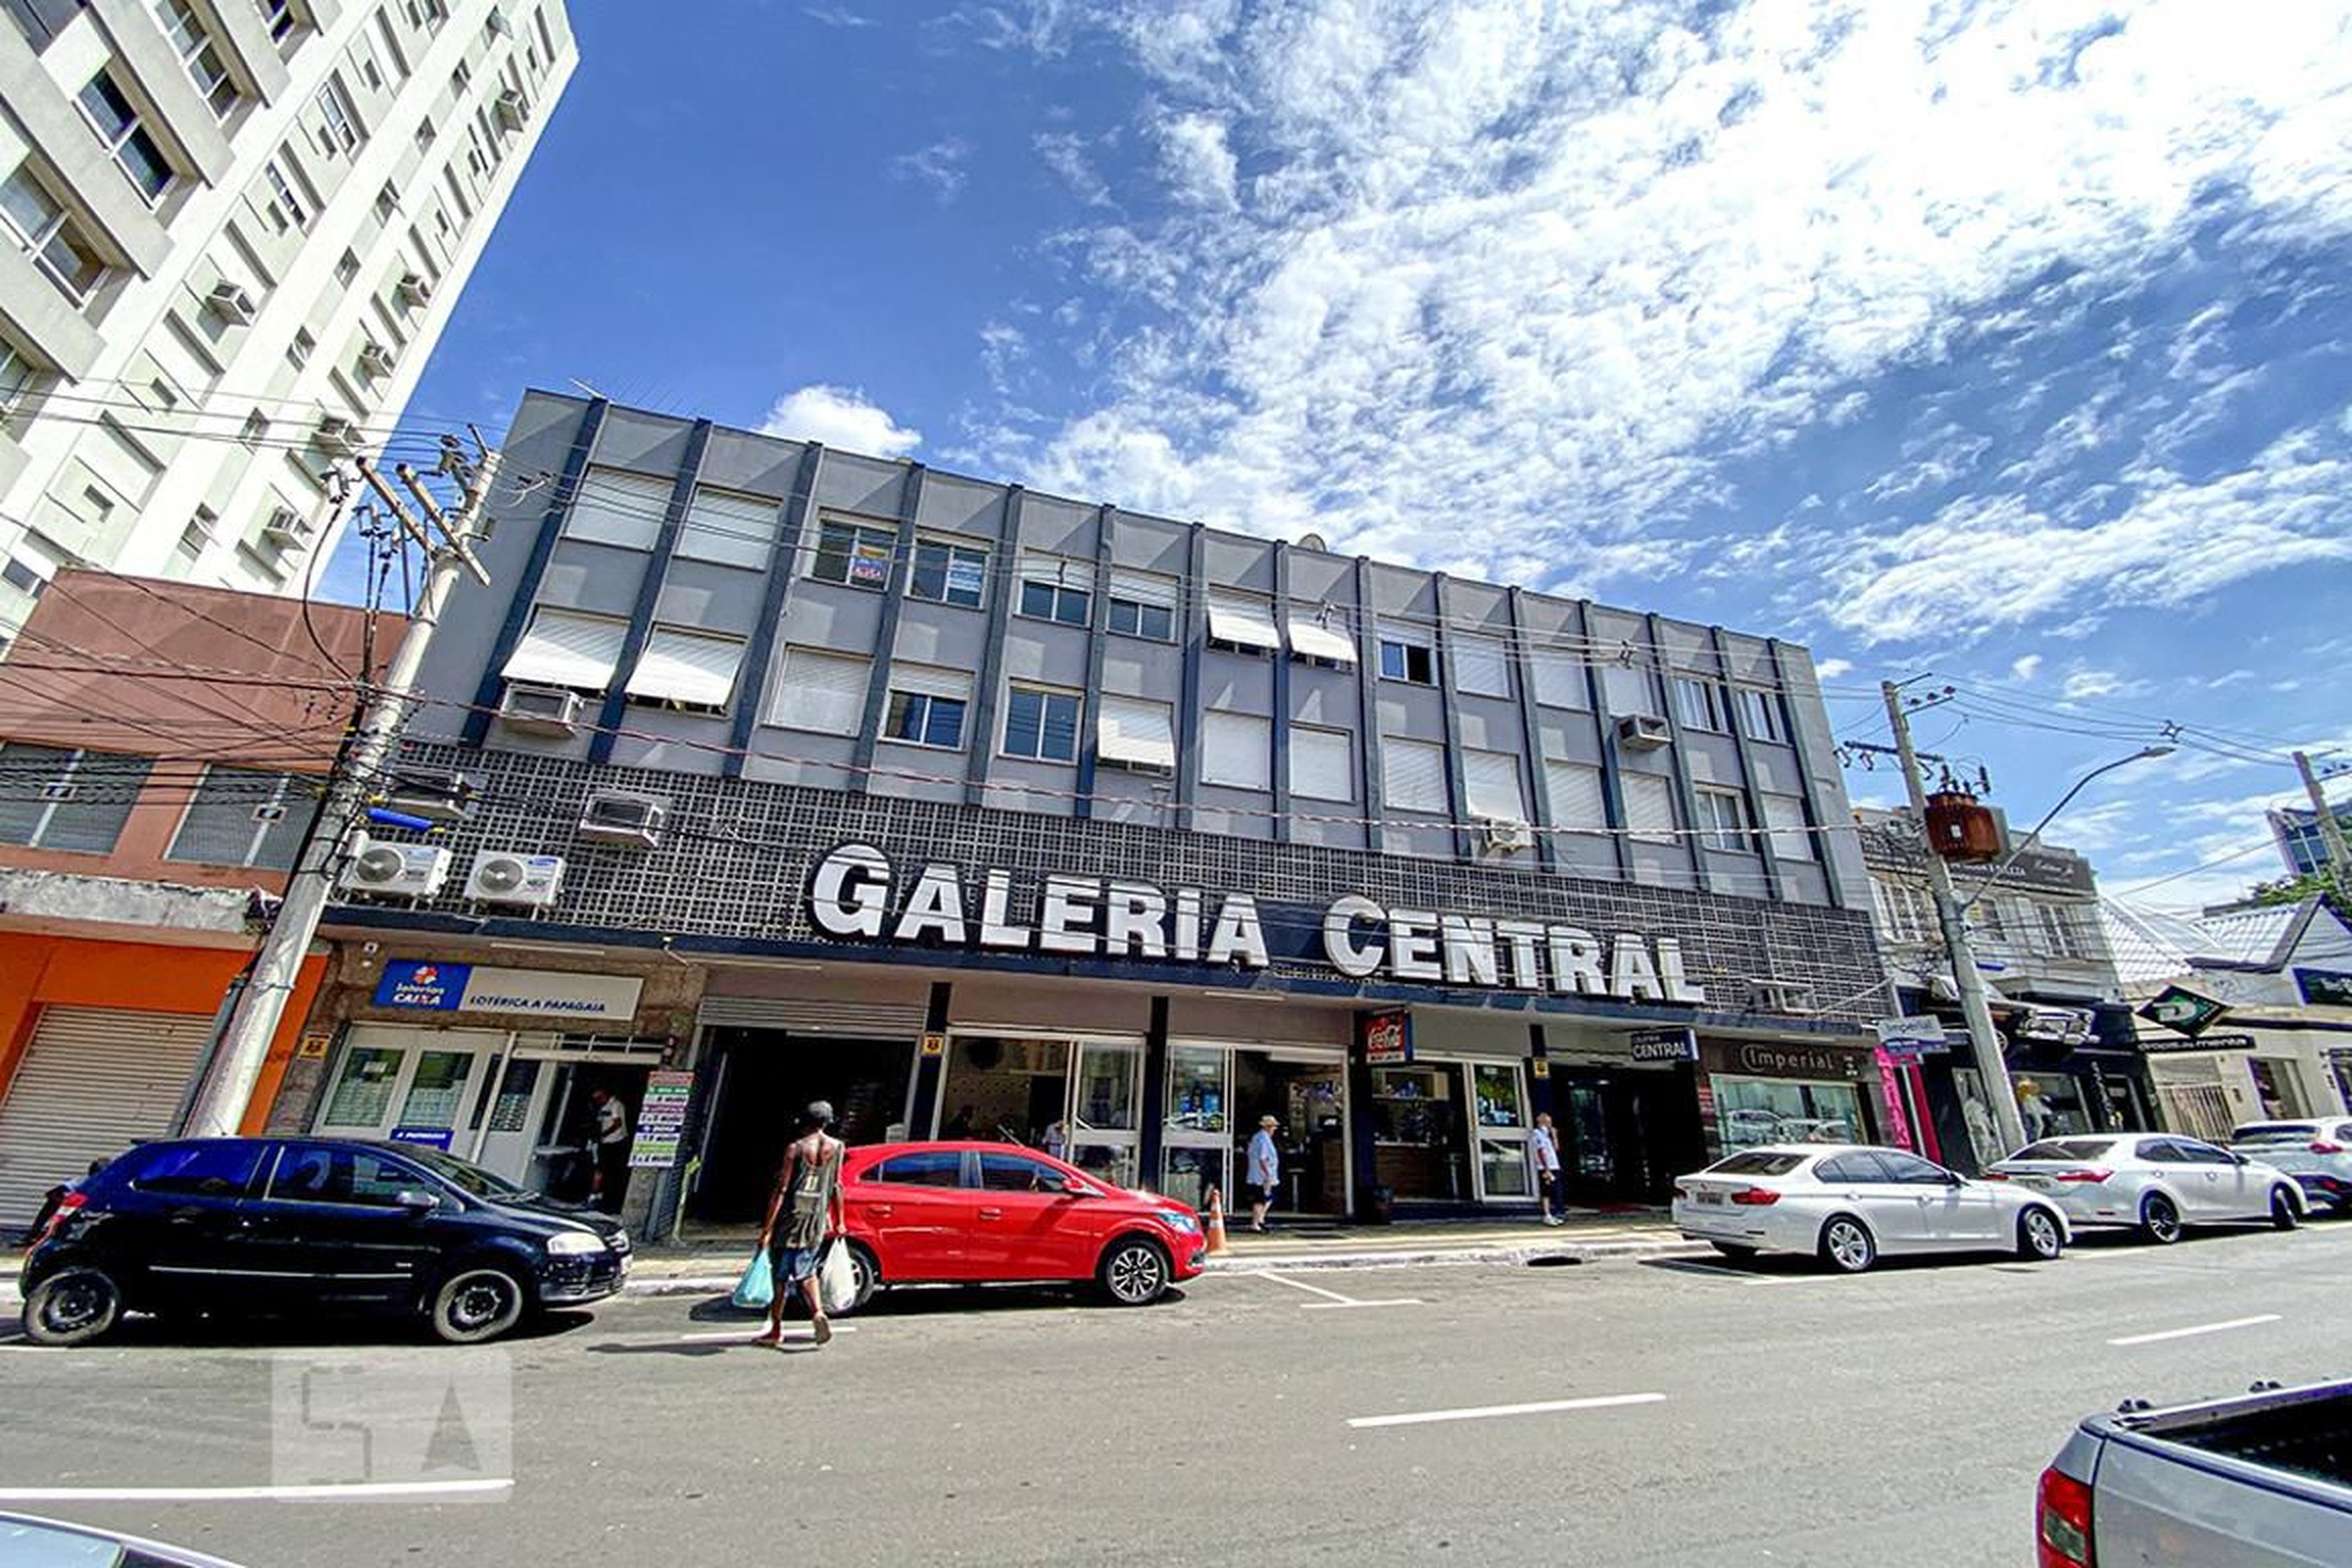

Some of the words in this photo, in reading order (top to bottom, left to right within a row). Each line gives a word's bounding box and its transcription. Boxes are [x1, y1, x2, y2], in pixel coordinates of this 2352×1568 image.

[813, 842, 1270, 968] GALERIA
[1323, 894, 1705, 1002] CENTRAL
[393, 993, 441, 1005] CAIXA
[1633, 1042, 1688, 1059] CENTRAL
[1749, 1047, 1833, 1070] Imperial
